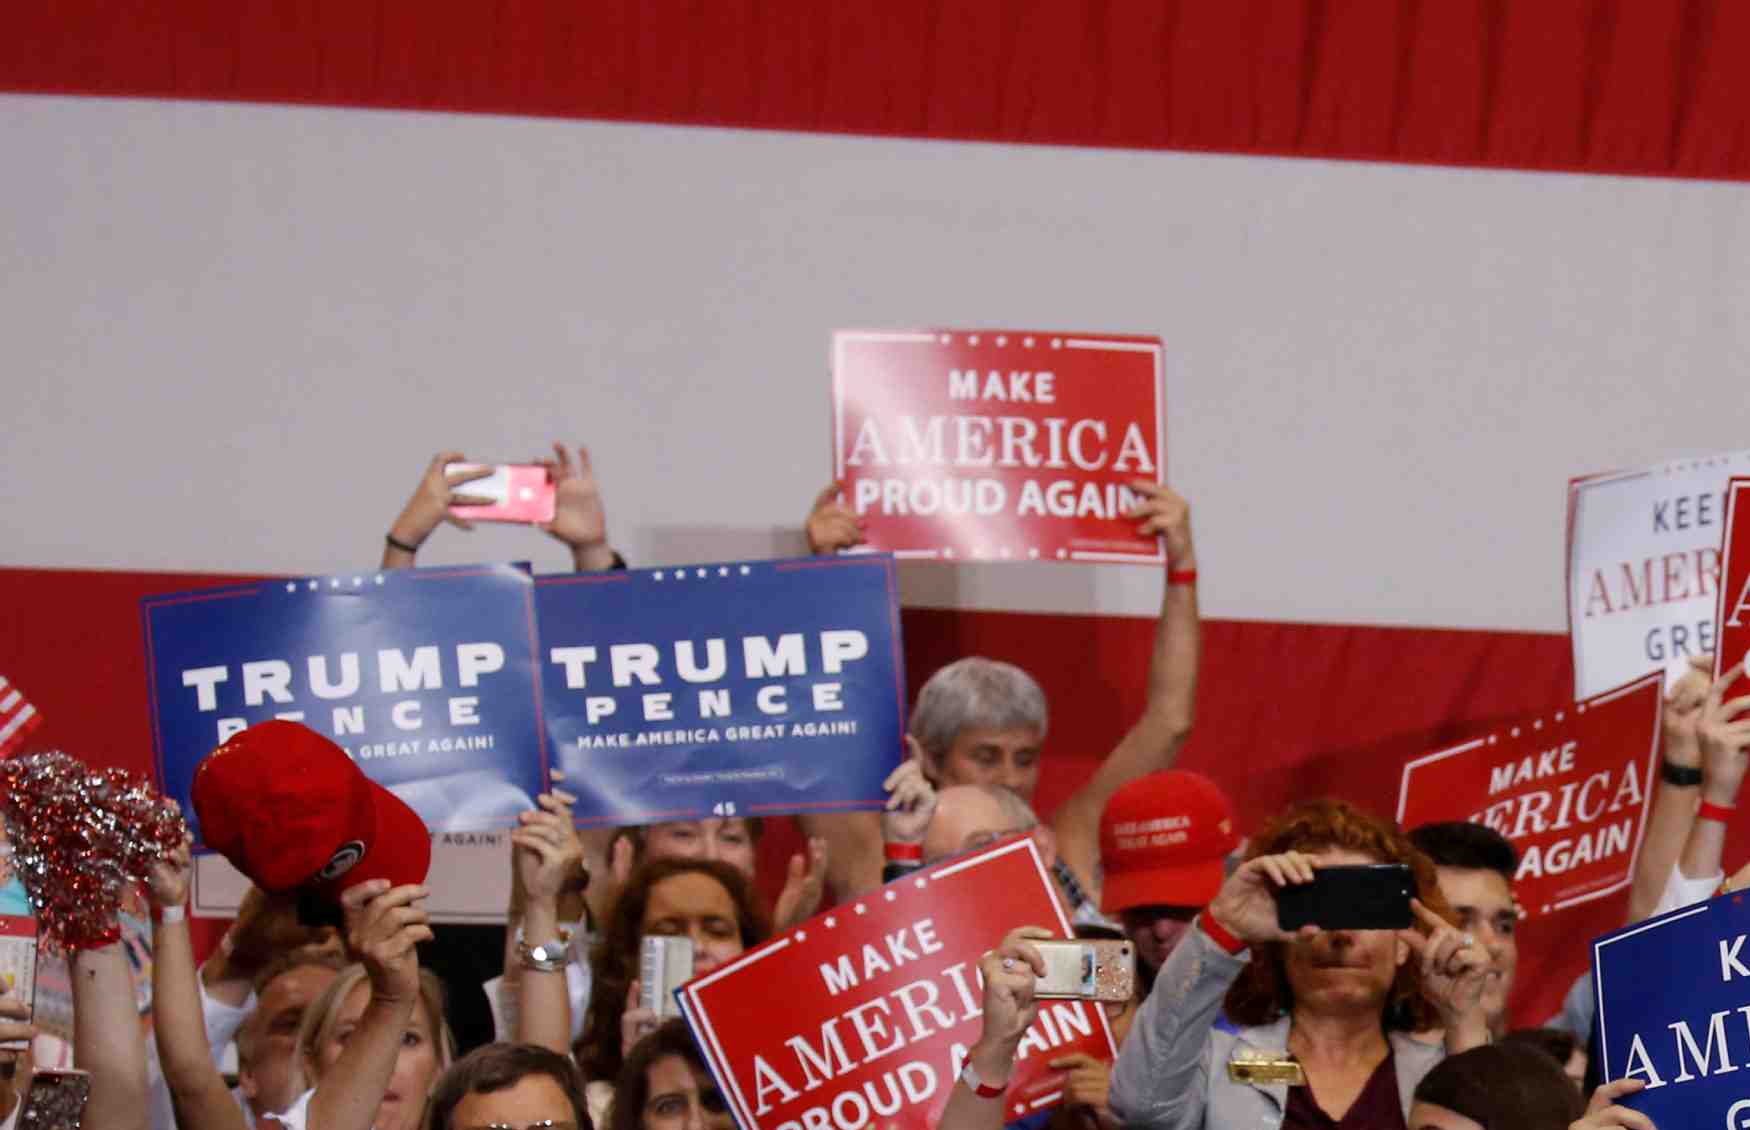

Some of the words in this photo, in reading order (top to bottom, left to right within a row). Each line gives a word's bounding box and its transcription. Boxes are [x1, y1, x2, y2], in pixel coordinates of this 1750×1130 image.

[948, 369, 1057, 403] MAKE
[846, 414, 1156, 473] AMERICA
[855, 478, 1008, 517] PROUD
[1017, 481, 1147, 519] AGAIN
[1652, 491, 1729, 534] KEE
[1583, 547, 1724, 619] AMER
[550, 629, 870, 690] TRUMP
[1645, 620, 1715, 661] GRE
[182, 641, 506, 713] TRUMP
[585, 682, 845, 725] PENCE
[216, 696, 481, 746] PNCE
[576, 730, 631, 750] MAKE
[634, 728, 720, 748] AMERICA
[725, 724, 787, 744] GREAT
[791, 719, 858, 739] AGAIN!
[359, 740, 421, 759] GREAT
[1488, 740, 1578, 796] MAKE
[1470, 759, 1644, 840] ERICA
[1513, 818, 1633, 881] AGAIN
[818, 917, 945, 996] MAKE
[752, 961, 986, 1117] AMERI
